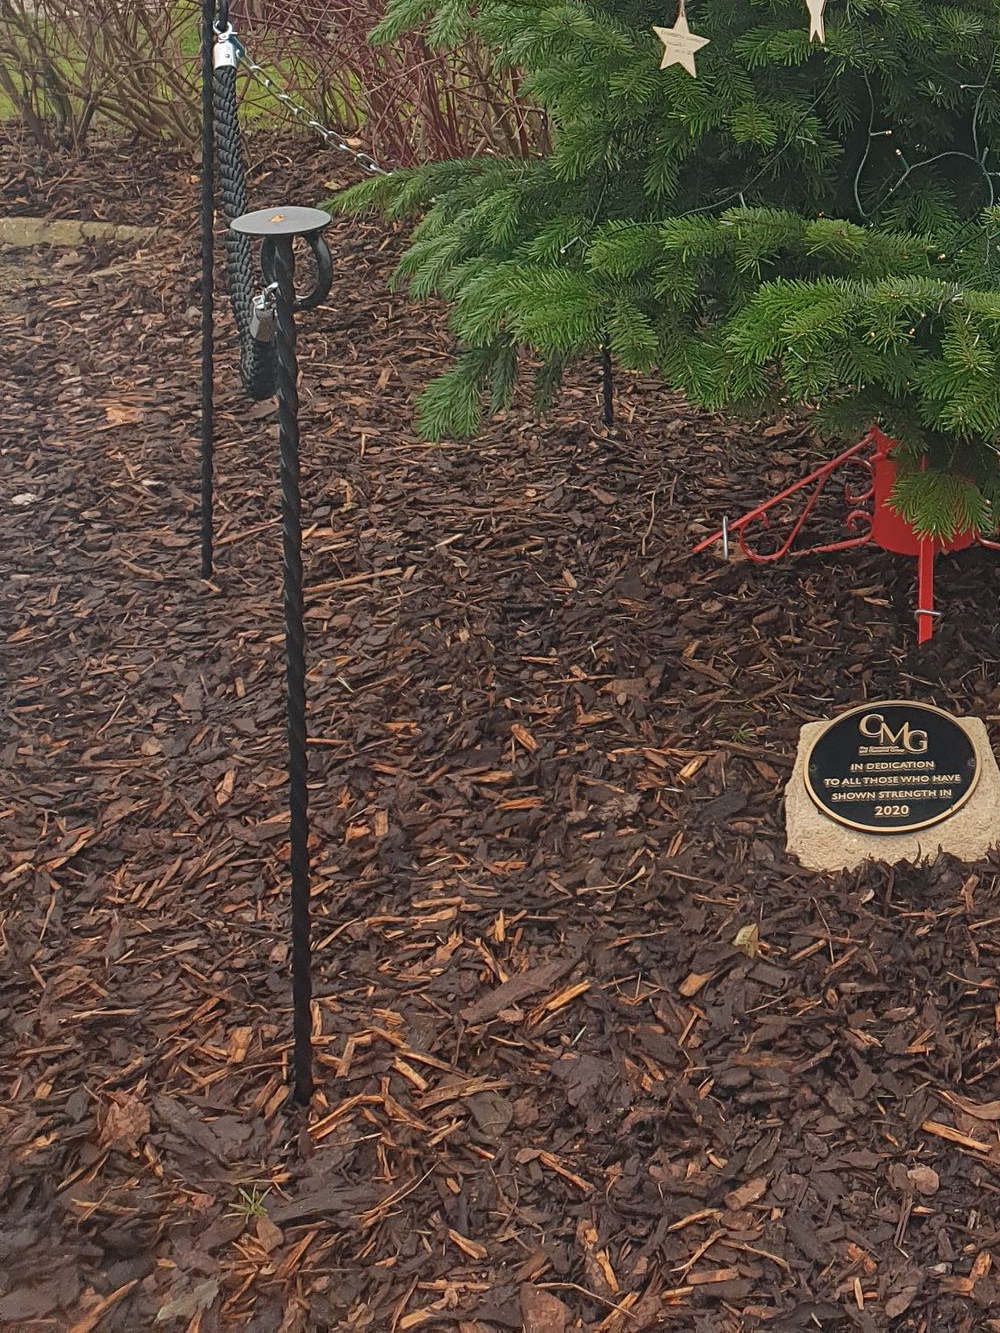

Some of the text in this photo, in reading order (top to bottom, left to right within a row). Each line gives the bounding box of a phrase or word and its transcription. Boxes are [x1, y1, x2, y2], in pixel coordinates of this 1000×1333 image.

[859, 713, 929, 753] CMG
[851, 760, 935, 771] IN DEDICATION
[824, 774, 961, 786] TO ALL THOSE WHO HAVE
[832, 789, 952, 801] SHOWN STRENGTH IN
[875, 805, 909, 816] 2020
